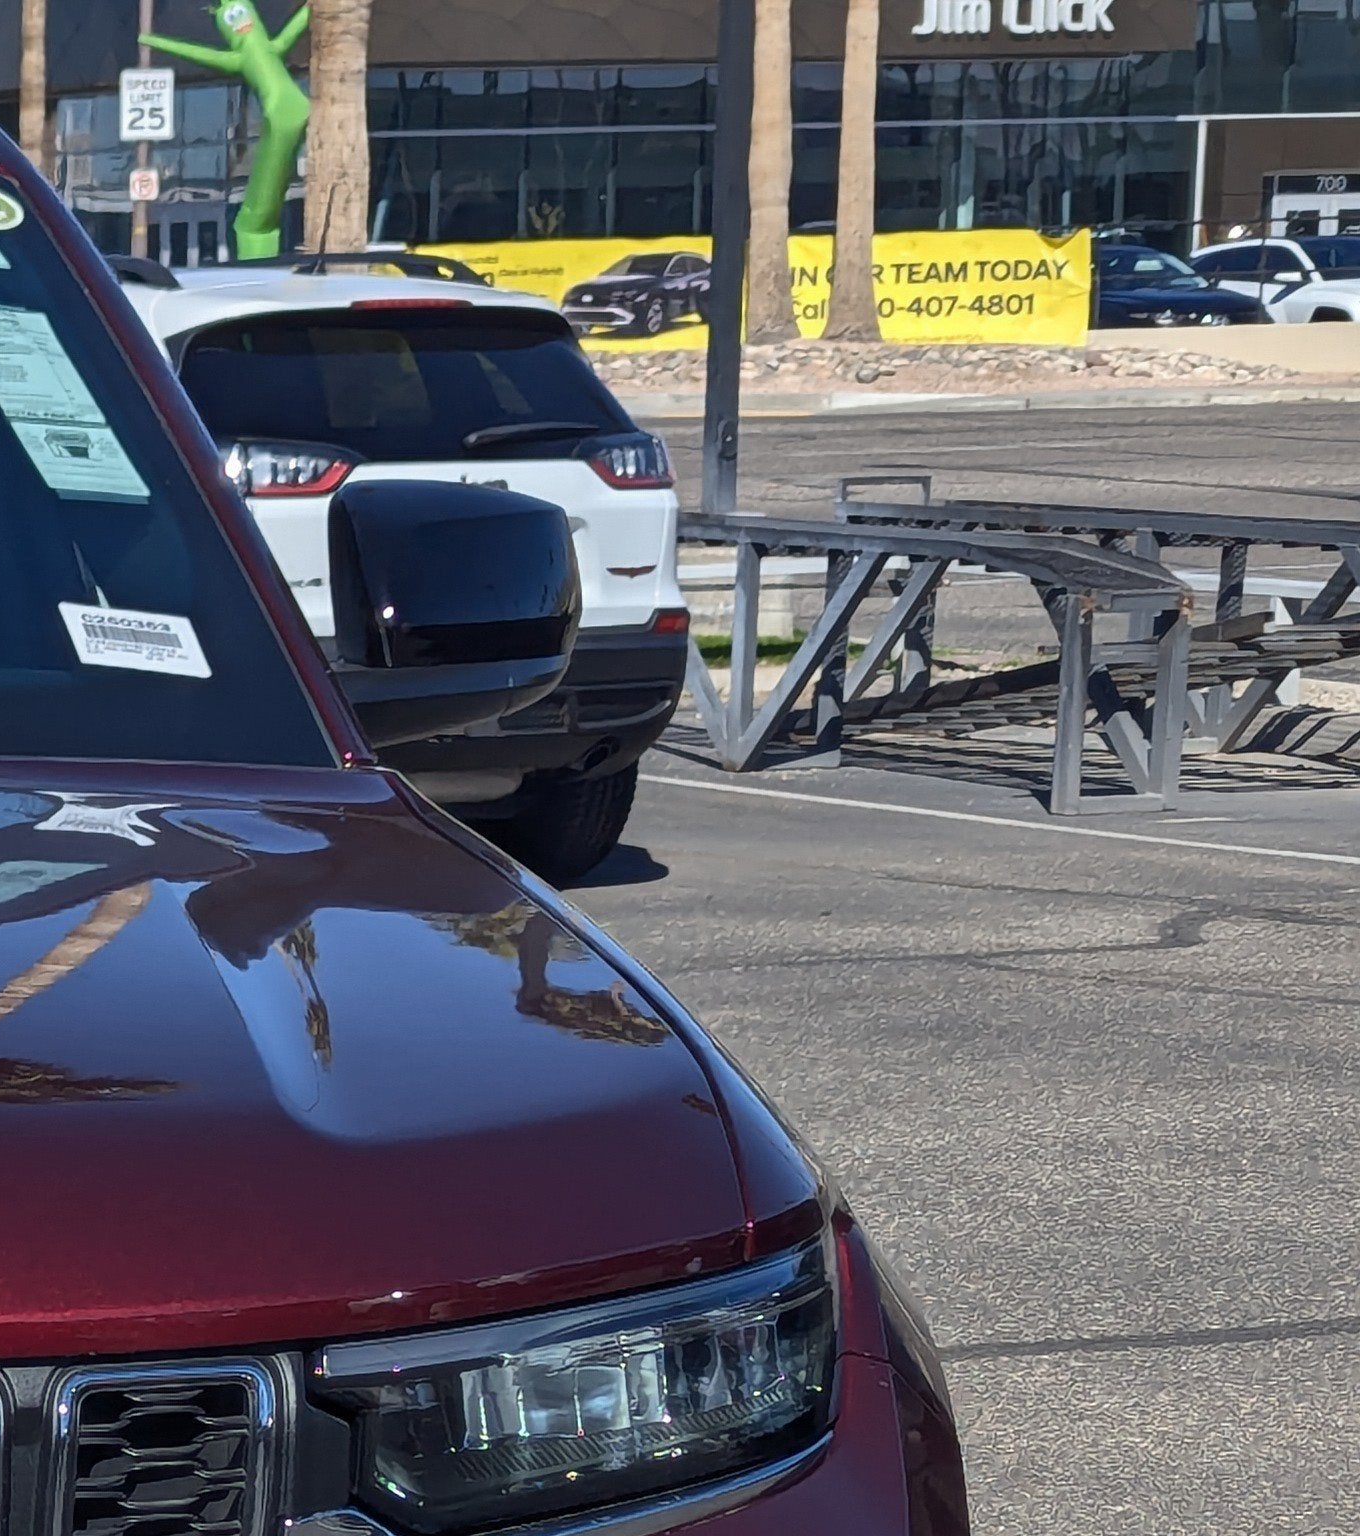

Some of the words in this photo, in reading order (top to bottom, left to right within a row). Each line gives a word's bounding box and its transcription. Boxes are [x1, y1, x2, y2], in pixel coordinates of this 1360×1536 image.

[911, 0, 991, 35] Jim
[1002, 0, 1115, 35] Click
[128, 107, 165, 130] 25
[1316, 175, 1347, 192] 700
[890, 261, 968, 284] TEAM
[974, 259, 1071, 282] TODAY
